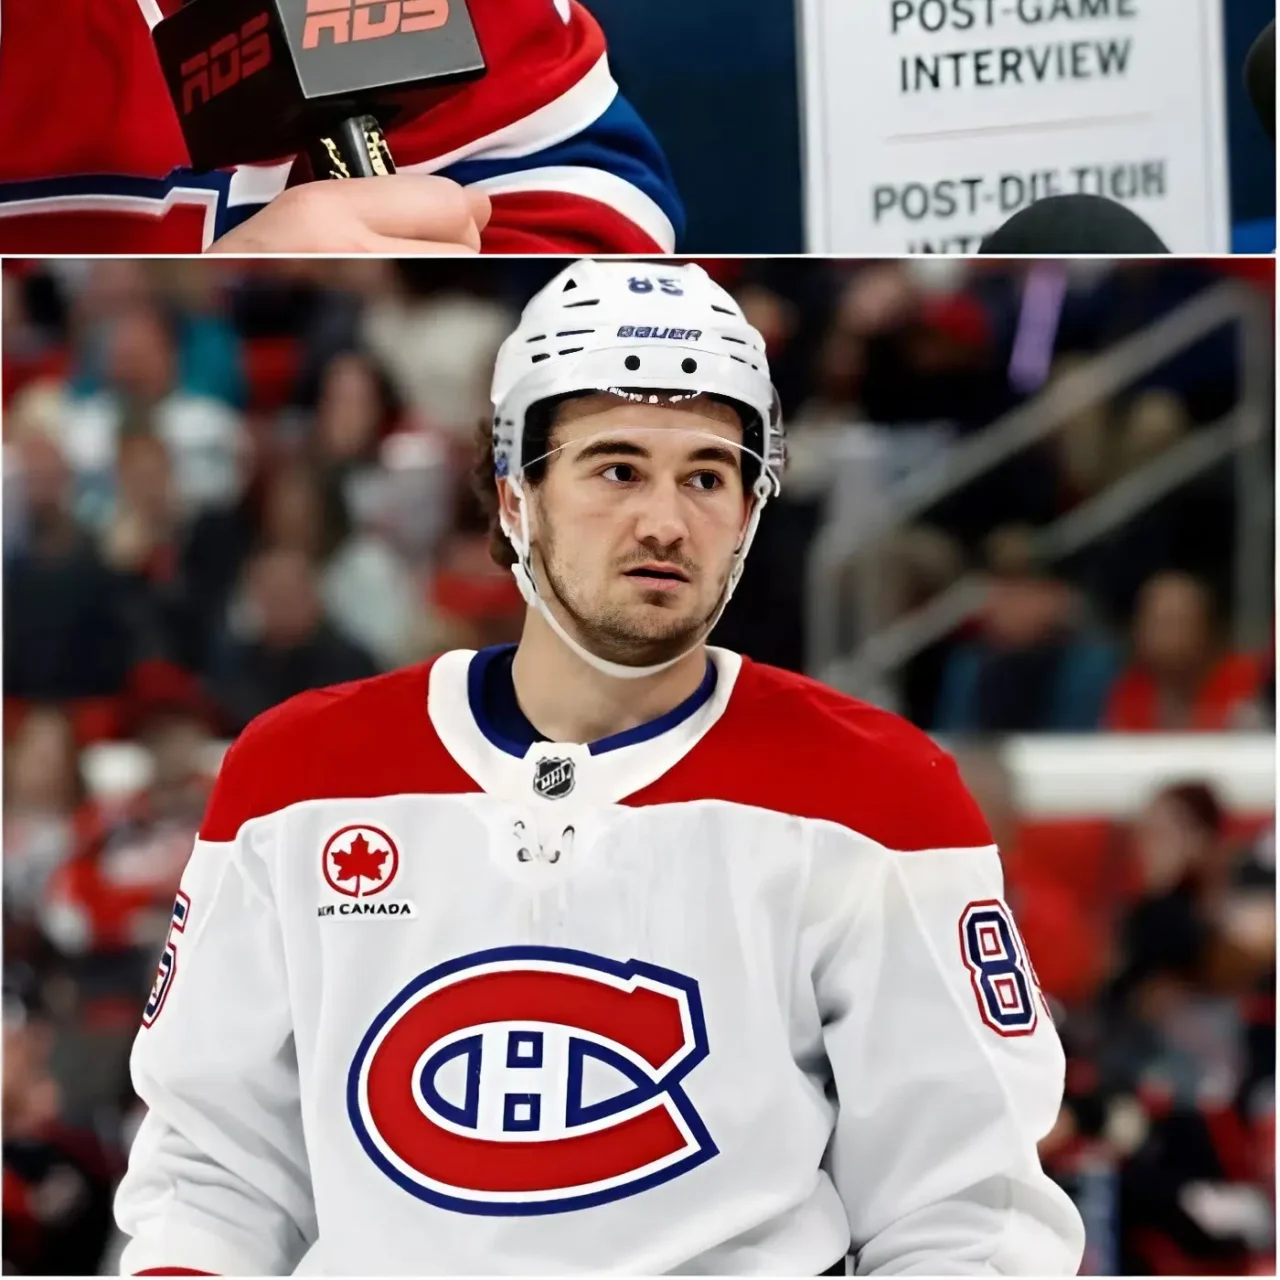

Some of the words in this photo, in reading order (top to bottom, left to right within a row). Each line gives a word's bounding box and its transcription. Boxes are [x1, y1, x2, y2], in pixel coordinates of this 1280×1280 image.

[180, 12, 271, 116] RDS
[900, 38, 1132, 93] INTERVIEW
[339, 903, 411, 915] CANADA
[958, 898, 1044, 1038] 8
